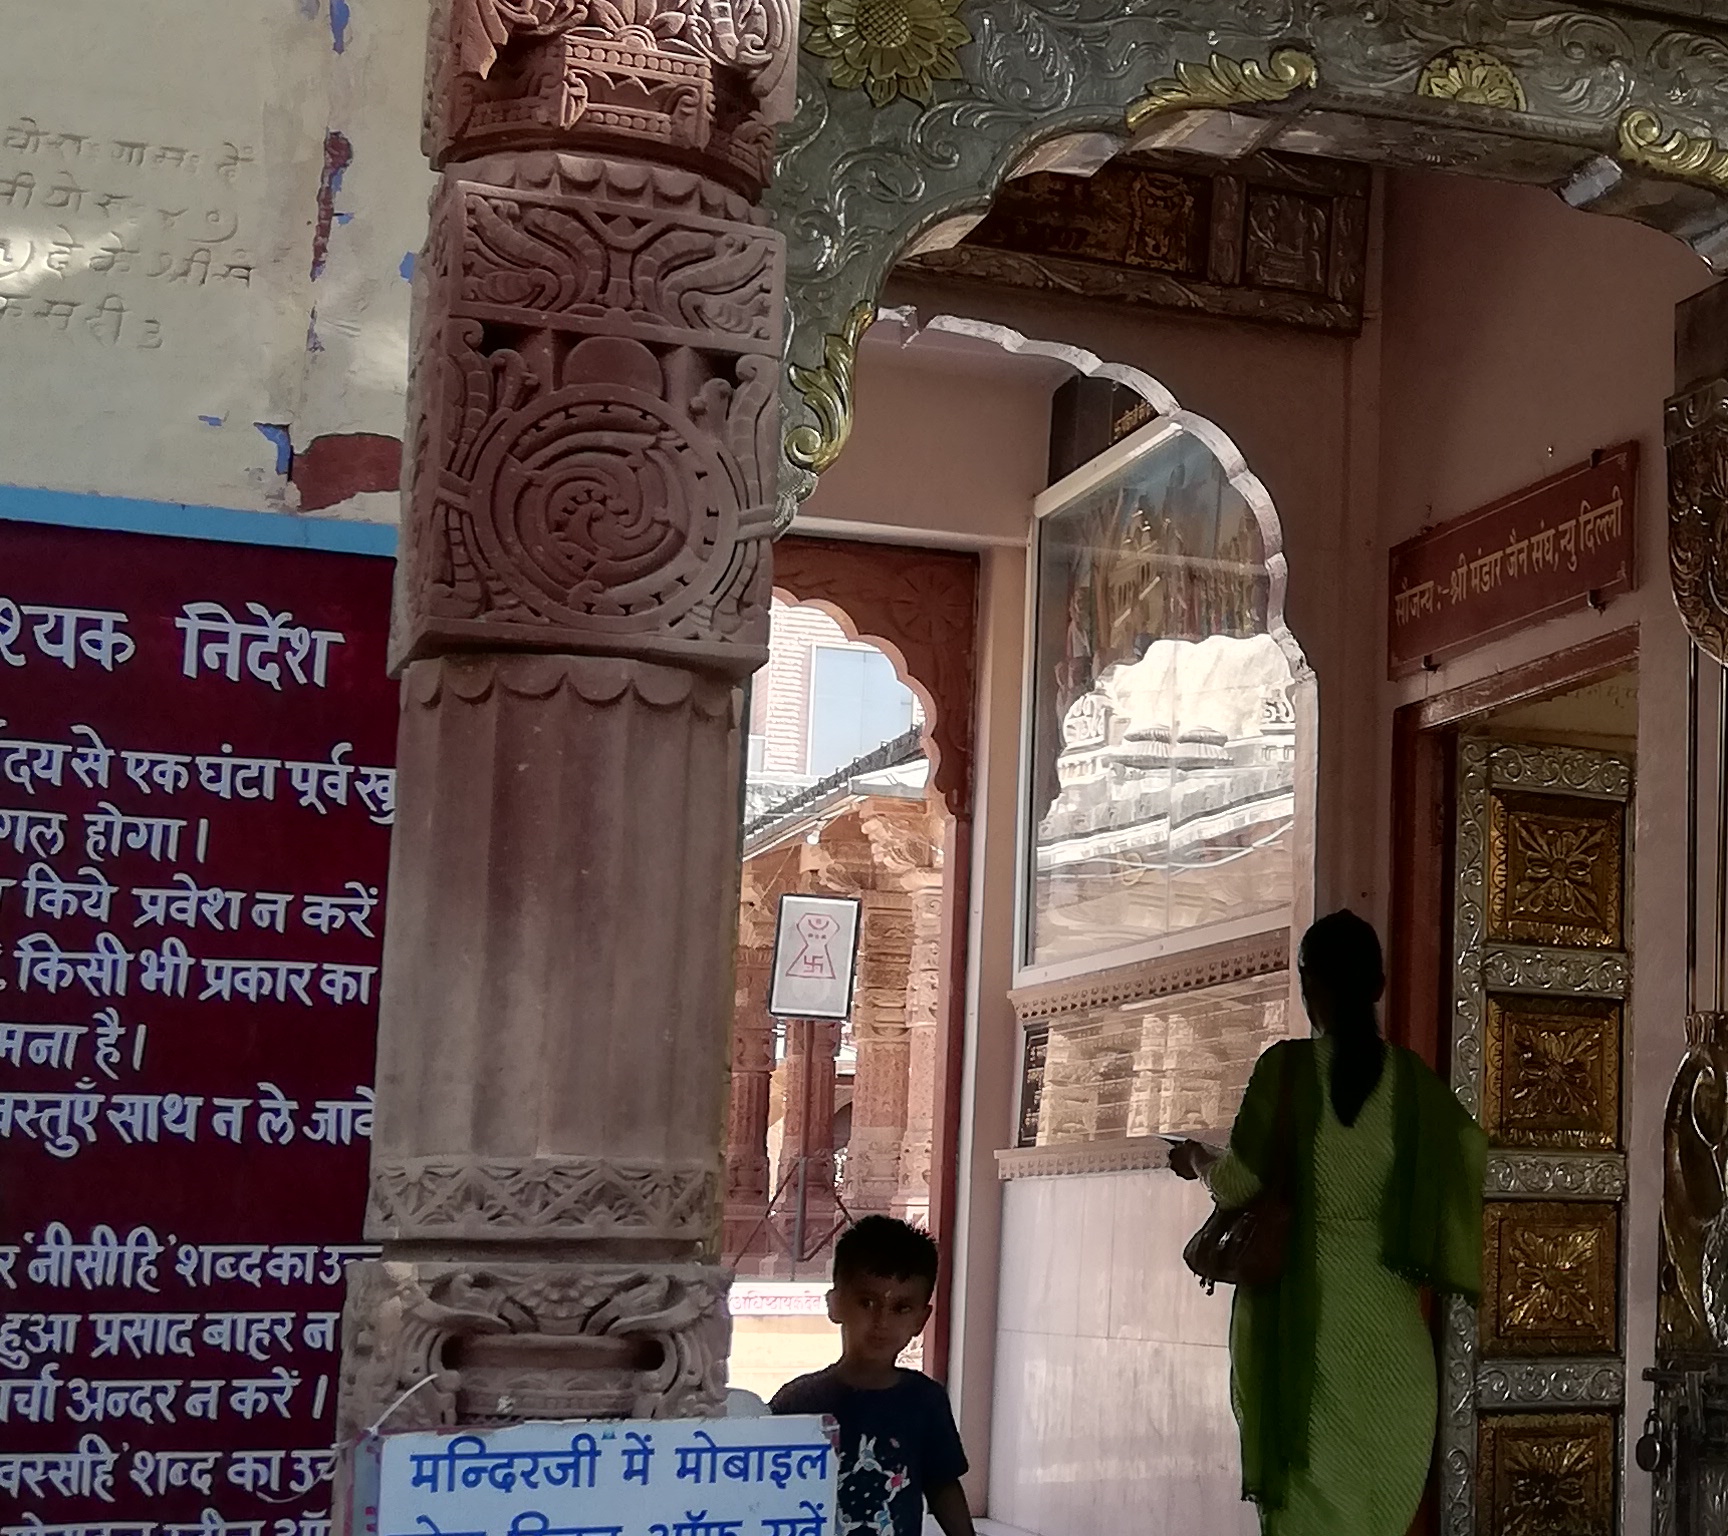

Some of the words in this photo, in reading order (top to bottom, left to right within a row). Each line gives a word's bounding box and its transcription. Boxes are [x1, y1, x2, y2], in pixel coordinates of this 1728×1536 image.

[1505, 527, 1529, 579] जैन
[1577, 484, 1623, 553] दिल्ली
[174, 601, 346, 691] निर्देश
[70, 724, 116, 789] से
[120, 750, 193, 795] एक
[194, 743, 282, 801] घंटा
[284, 742, 356, 815] पूर्व
[21, 861, 120, 923] किये
[130, 872, 248, 931] प्रवेश
[251, 891, 295, 934] न
[301, 881, 379, 938] करें
[12, 931, 136, 997] किसी
[139, 936, 196, 998] भी
[198, 958, 319, 1007] प्रकार
[319, 962, 379, 1005] का
[105, 1093, 205, 1144] साथ
[212, 1097, 254, 1144] न
[256, 1081, 300, 1145] ले
[88, 1312, 201, 1359] प्रसाद
[202, 1311, 297, 1361] बाहर
[303, 1311, 341, 1352] न
[65, 1377, 181, 1425] अन्दर
[184, 1379, 227, 1420] न
[229, 1366, 302, 1420] करें
[129, 1450, 220, 1497] शब्द
[227, 1450, 287, 1492] का
[620, 1432, 655, 1486] में
[675, 1431, 832, 1489] मोबाइल
